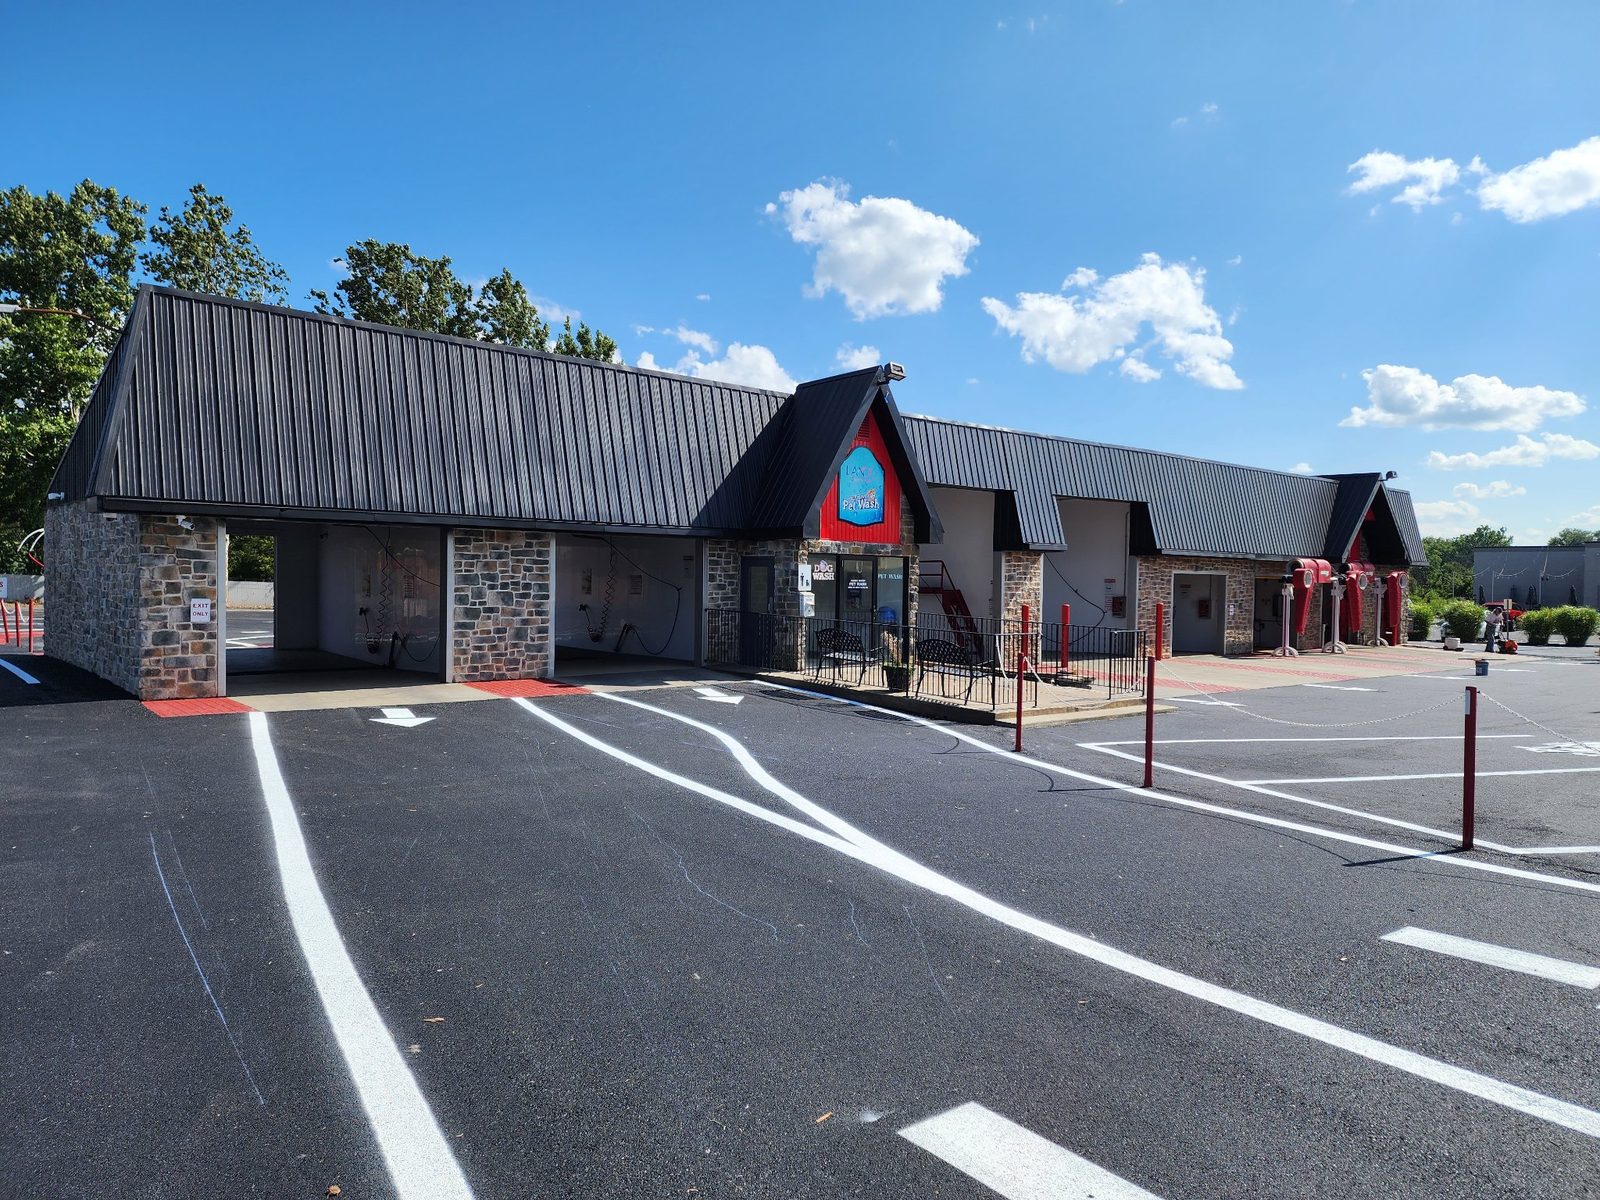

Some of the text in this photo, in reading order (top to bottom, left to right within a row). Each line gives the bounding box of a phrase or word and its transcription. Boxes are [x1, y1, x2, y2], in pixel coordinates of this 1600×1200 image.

[843, 498, 880, 510] Pet Wash
[814, 562, 833, 572] DOG
[812, 572, 835, 581] WASH
